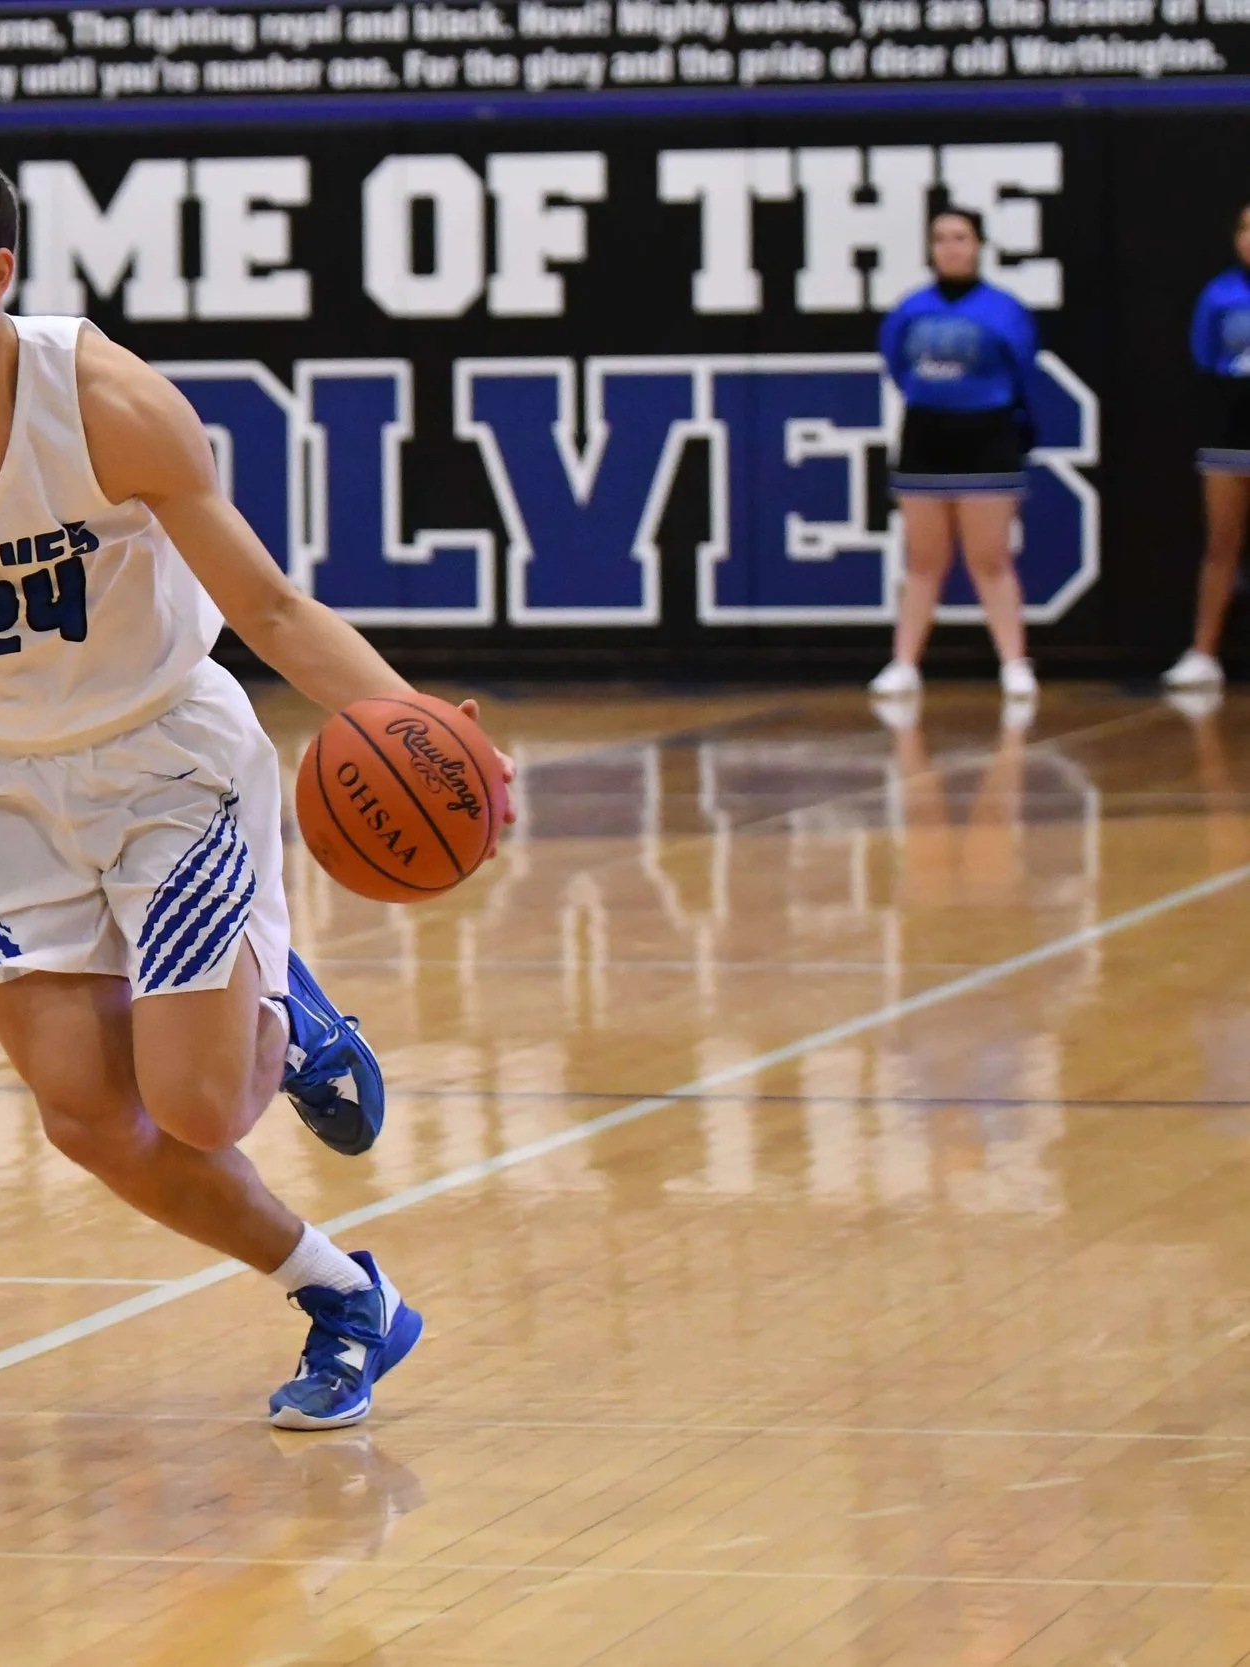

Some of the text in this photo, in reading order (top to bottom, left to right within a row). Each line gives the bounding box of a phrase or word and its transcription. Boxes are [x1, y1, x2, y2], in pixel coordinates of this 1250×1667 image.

[22, 58, 96, 94] until
[204, 53, 322, 91] number
[404, 49, 458, 86] For
[464, 48, 519, 86] the
[524, 47, 606, 92] glory
[611, 45, 674, 82] and
[679, 44, 733, 81] the
[739, 42, 824, 84] pride
[830, 40, 866, 78] of
[872, 41, 946, 77] dear
[954, 37, 1007, 76] old
[71, 11, 129, 47] The
[134, 9, 255, 52] fighting
[260, 6, 341, 48] royal
[347, 5, 408, 42] and
[617, 0, 728, 41] Mighty
[860, 0, 920, 37] you
[926, 0, 982, 30] are
[1050, 0, 1155, 26] leader
[1162, 0, 1198, 24] of
[363, 154, 608, 321] OF
[658, 143, 1062, 314] THE
[337, 761, 418, 868] OHSAA
[385, 717, 482, 821] Rawlings
